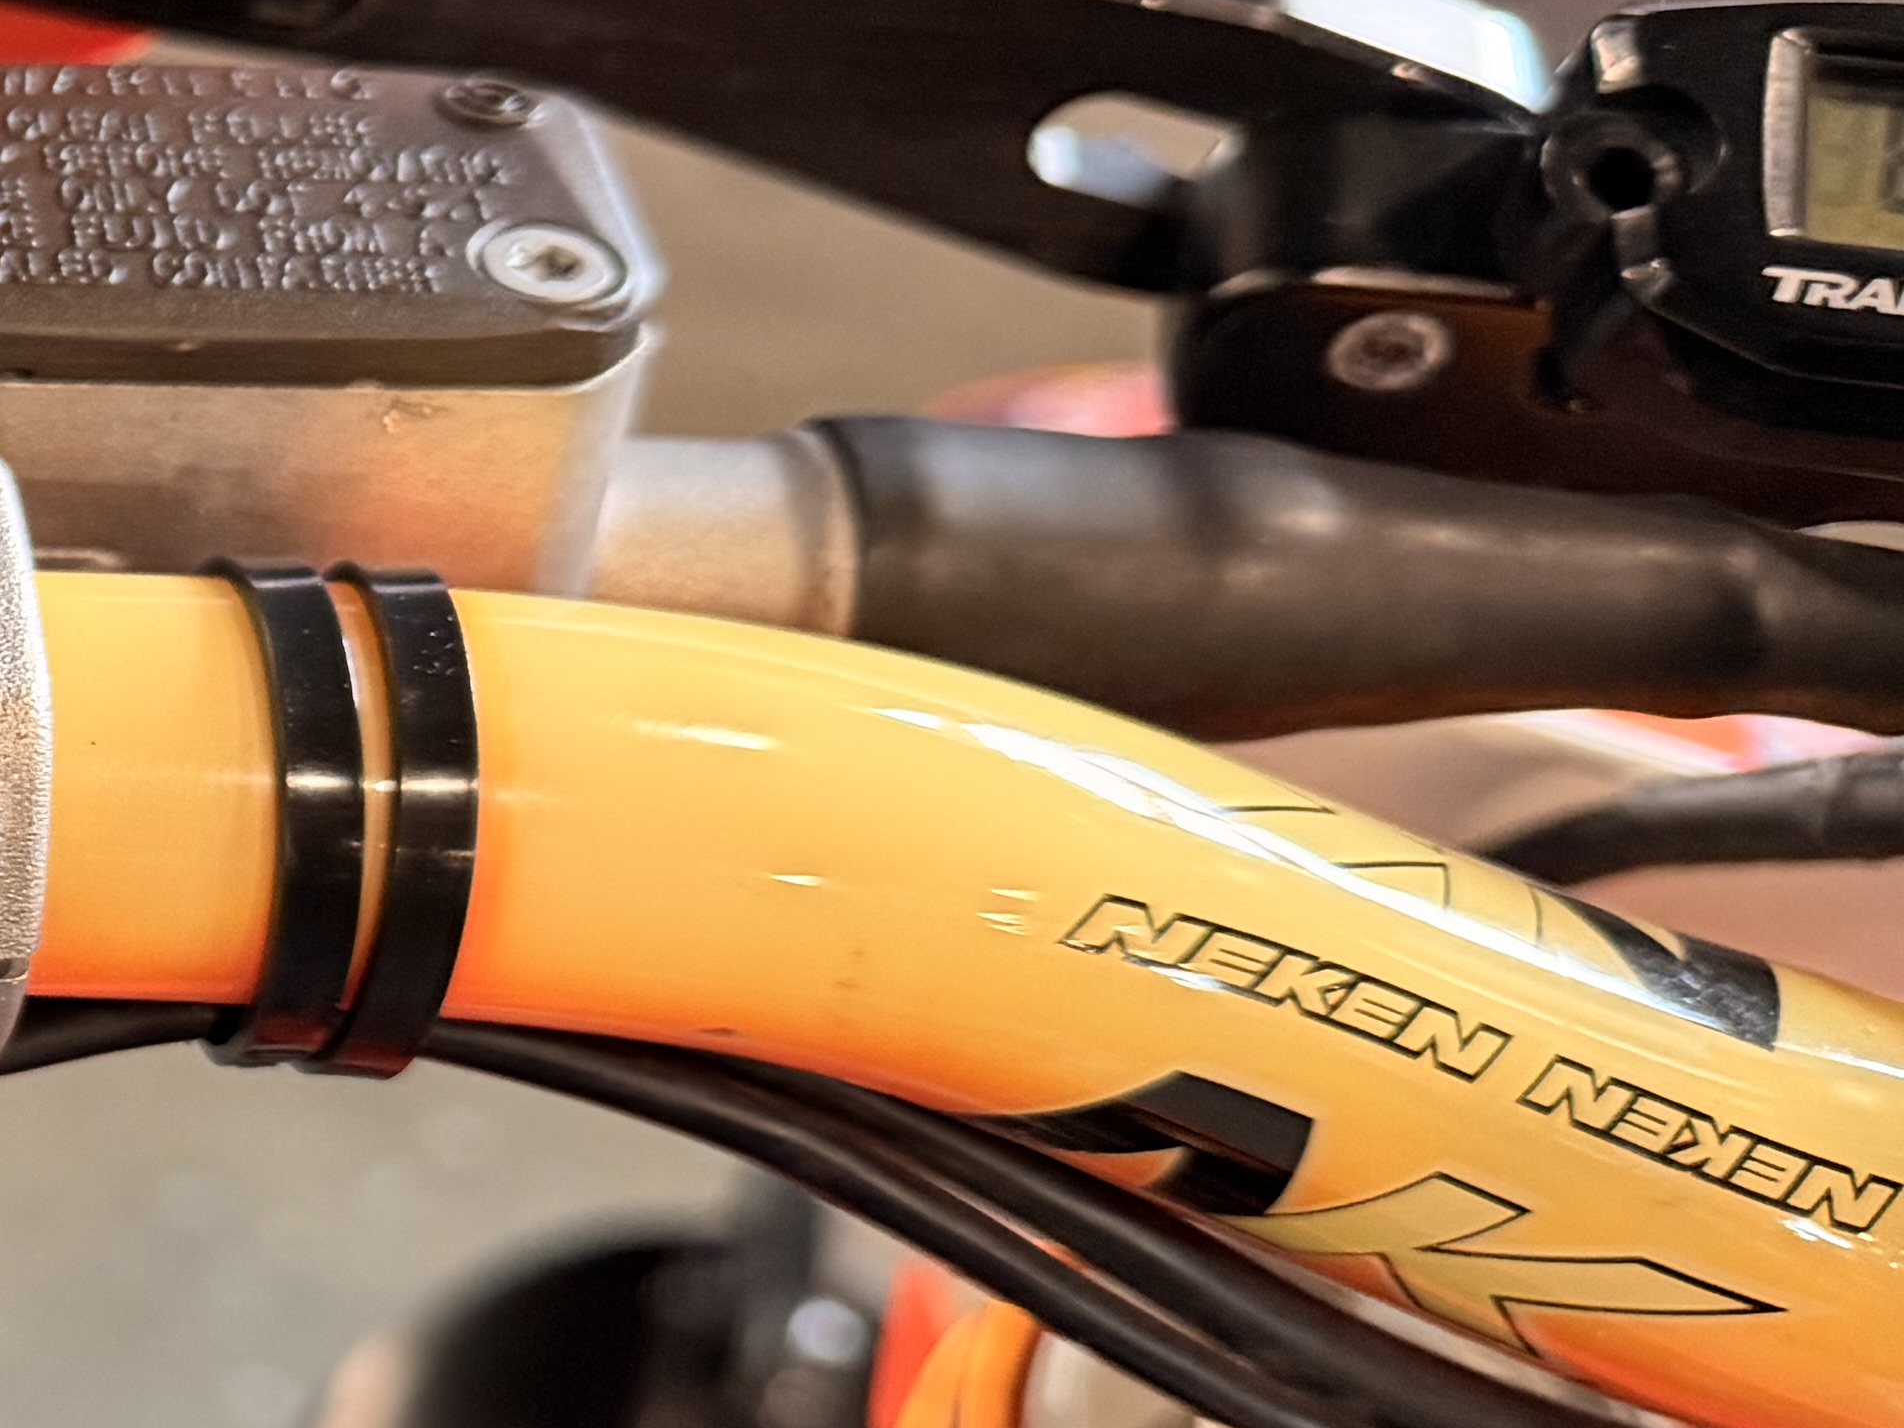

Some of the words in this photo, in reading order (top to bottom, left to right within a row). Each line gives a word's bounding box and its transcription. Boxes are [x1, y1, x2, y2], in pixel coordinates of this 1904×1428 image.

[58, 174, 194, 216] ONLY
[70, 210, 242, 254] FLUID
[256, 217, 396, 256] FROM
[1762, 266, 1904, 316] TRA
[1058, 893, 1514, 1082] NEKEN
